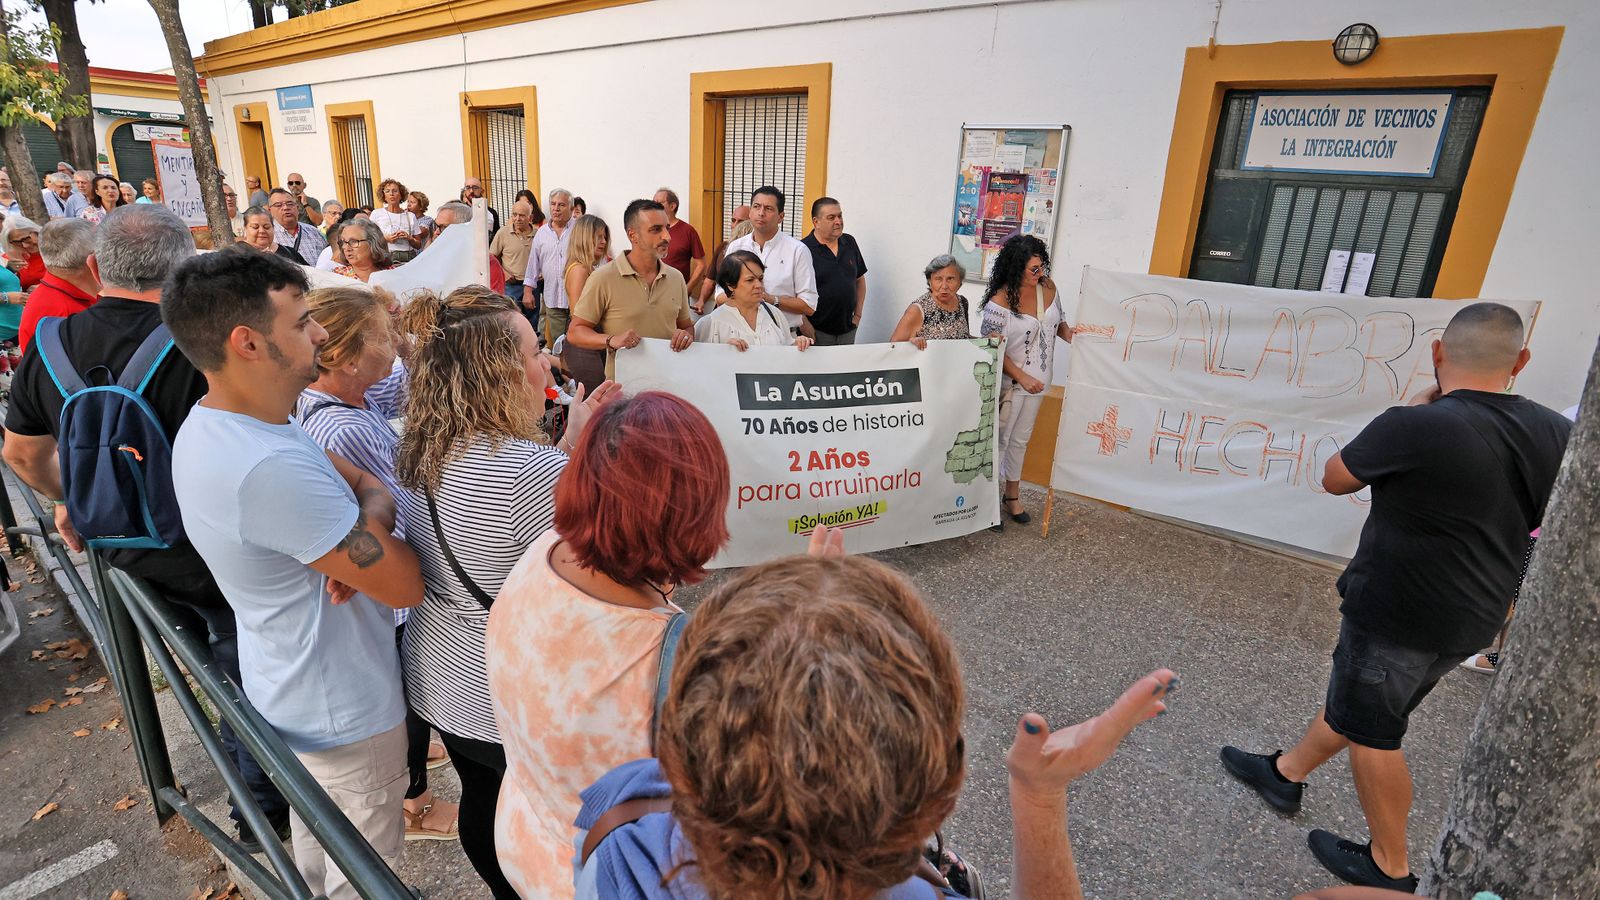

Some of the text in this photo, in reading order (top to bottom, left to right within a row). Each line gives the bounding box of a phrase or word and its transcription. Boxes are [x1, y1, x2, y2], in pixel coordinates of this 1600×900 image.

[1260, 104, 1437, 128] ASOCIACIÓN DE VECINOS
[1280, 135, 1398, 159] LA INTEGRACIÓN
[161, 156, 193, 173] MENTIR
[1119, 293, 1446, 401] PALABRA
[754, 377, 903, 402] La Asunción
[741, 410, 924, 435] 70 Años de historia
[788, 447, 871, 472] 2 Años
[1149, 407, 1371, 508] HECHO
[737, 468, 921, 509] para arruinarla
[794, 501, 879, 534] ¡Solución YA!
